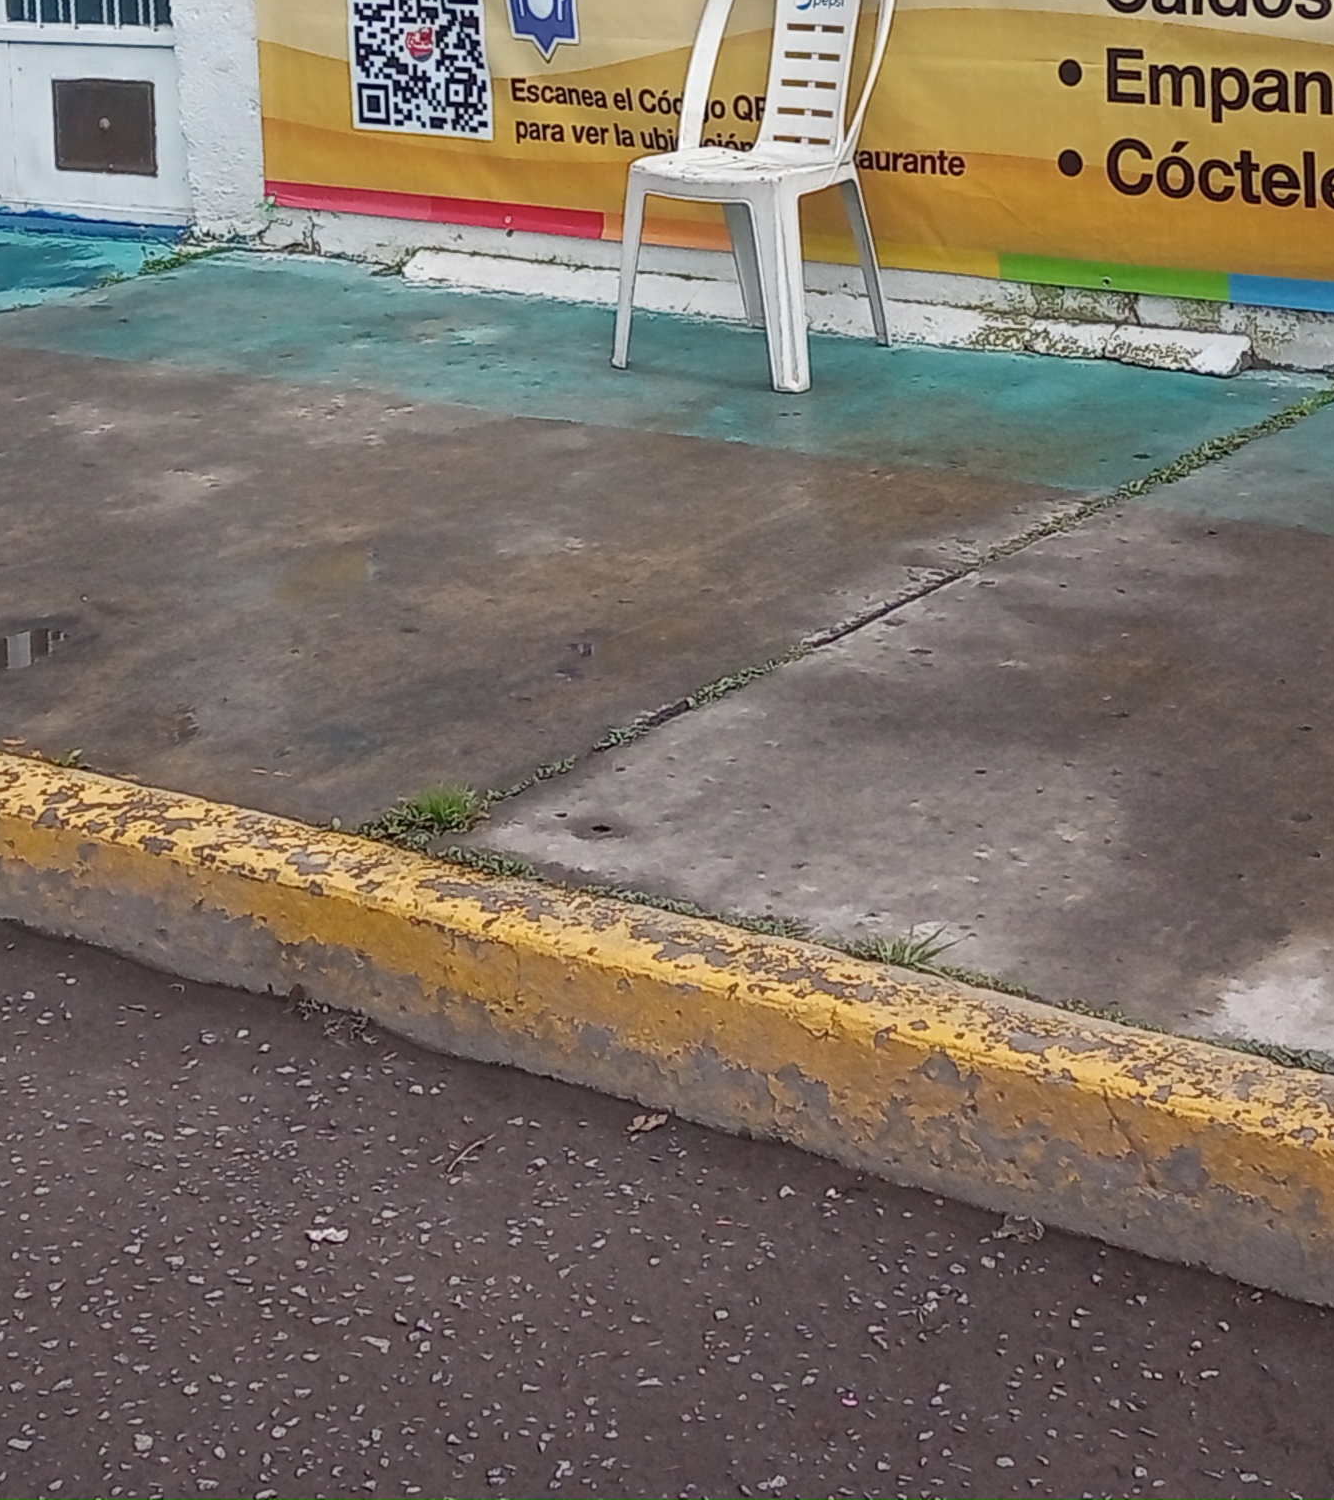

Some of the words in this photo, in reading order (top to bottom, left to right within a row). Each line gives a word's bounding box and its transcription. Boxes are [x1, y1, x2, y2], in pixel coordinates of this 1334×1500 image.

[510, 77, 608, 110] Escanea
[613, 88, 634, 112] el
[515, 119, 565, 144] para
[571, 124, 609, 146] ver
[613, 123, 635, 148] la
